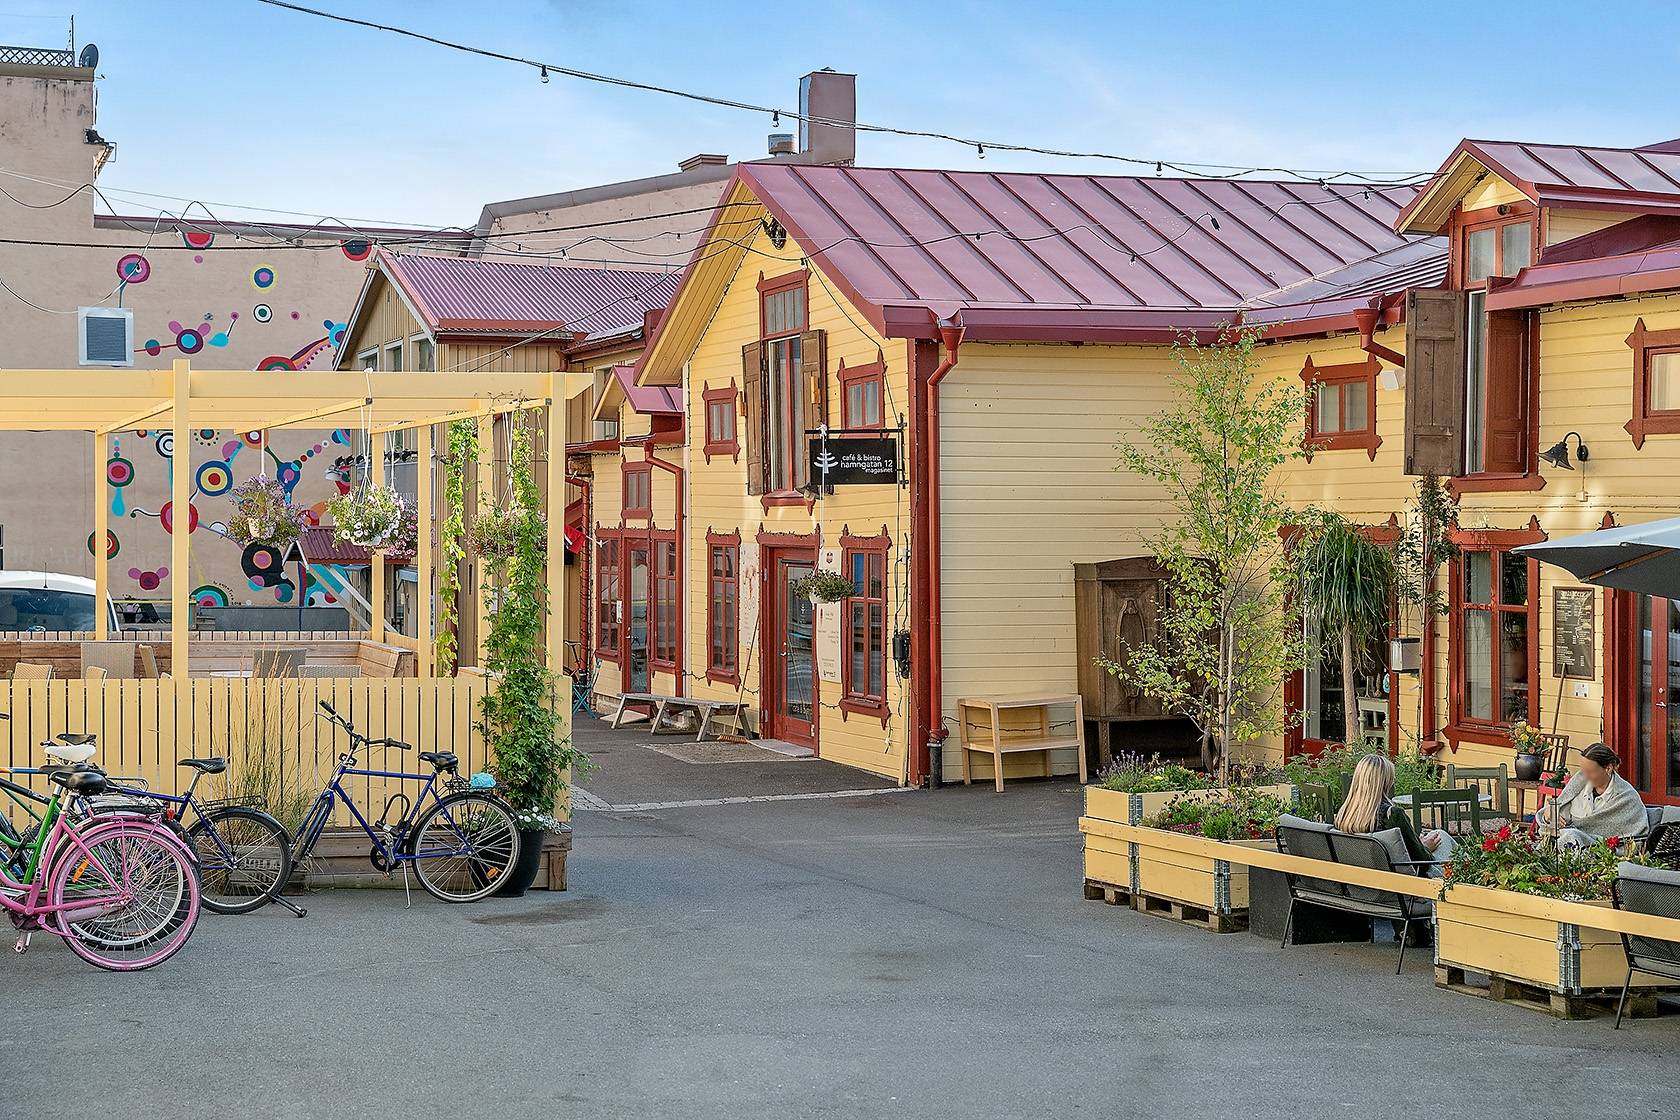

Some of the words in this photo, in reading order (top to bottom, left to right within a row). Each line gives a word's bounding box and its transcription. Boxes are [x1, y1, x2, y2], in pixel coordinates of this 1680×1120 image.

[842, 453, 856, 461] café
[857, 453, 863, 461] &
[863, 453, 882, 461] bistro
[840, 460, 883, 470] hamngatan
[884, 459, 893, 468] 12
[865, 467, 893, 475] magasinet
